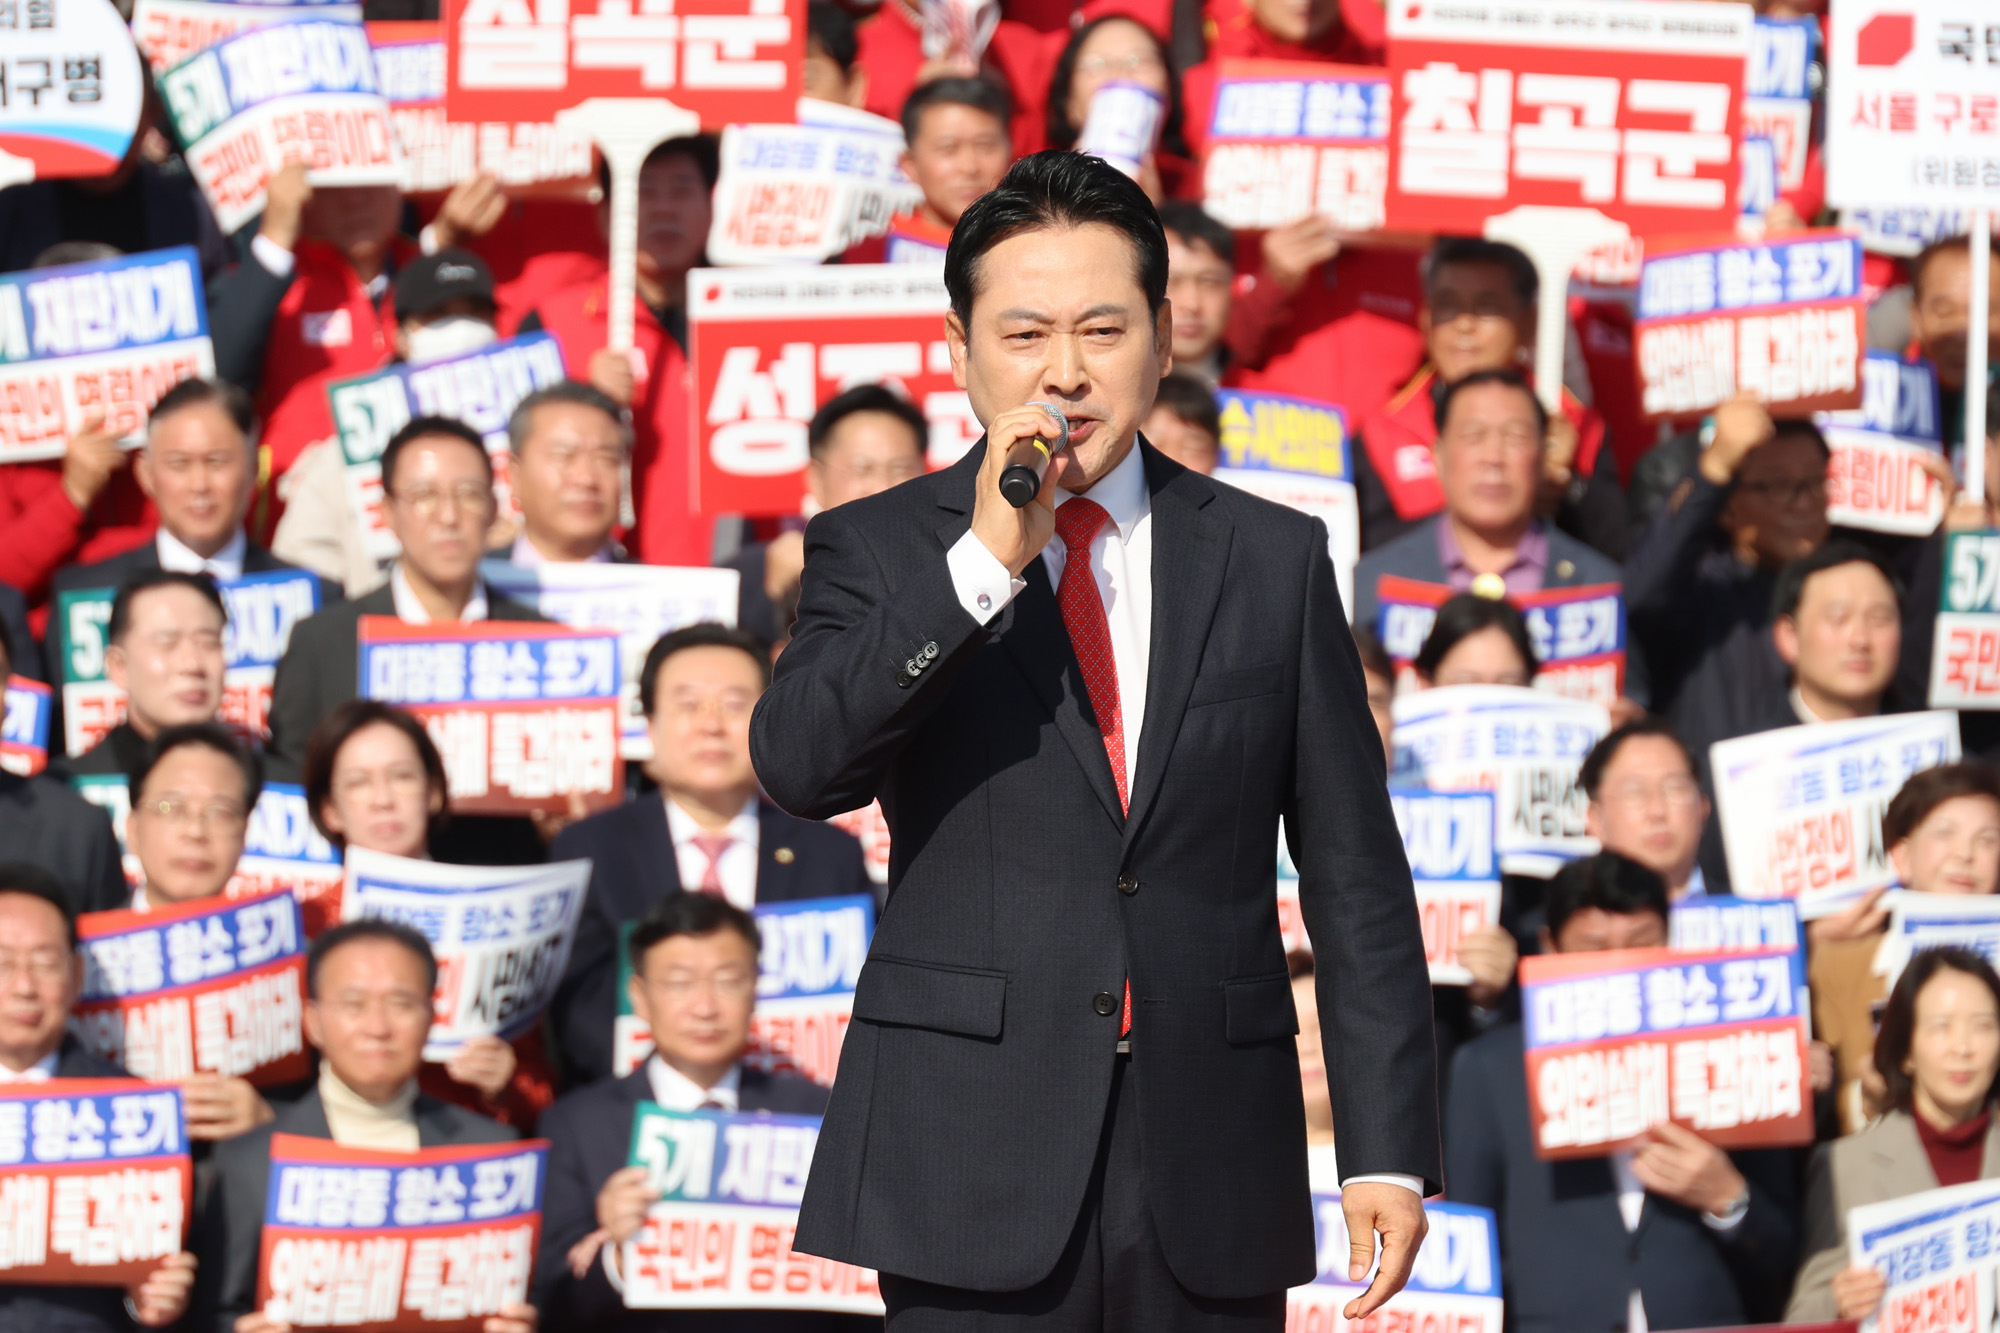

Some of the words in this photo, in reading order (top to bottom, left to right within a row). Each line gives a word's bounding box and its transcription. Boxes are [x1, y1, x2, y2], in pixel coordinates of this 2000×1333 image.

[0, 56, 102, 107] 구병
[457, 0, 792, 90] 칠곡군
[1400, 62, 1732, 209] 칠곡군
[1852, 92, 1917, 133] 서울
[1720, 955, 1793, 1022] 포기
[31, 1098, 106, 1163] 항소
[108, 1091, 180, 1156] 포기
[636, 1113, 717, 1199] 5개
[393, 1164, 467, 1227] 항소
[468, 1151, 539, 1220] 포기
